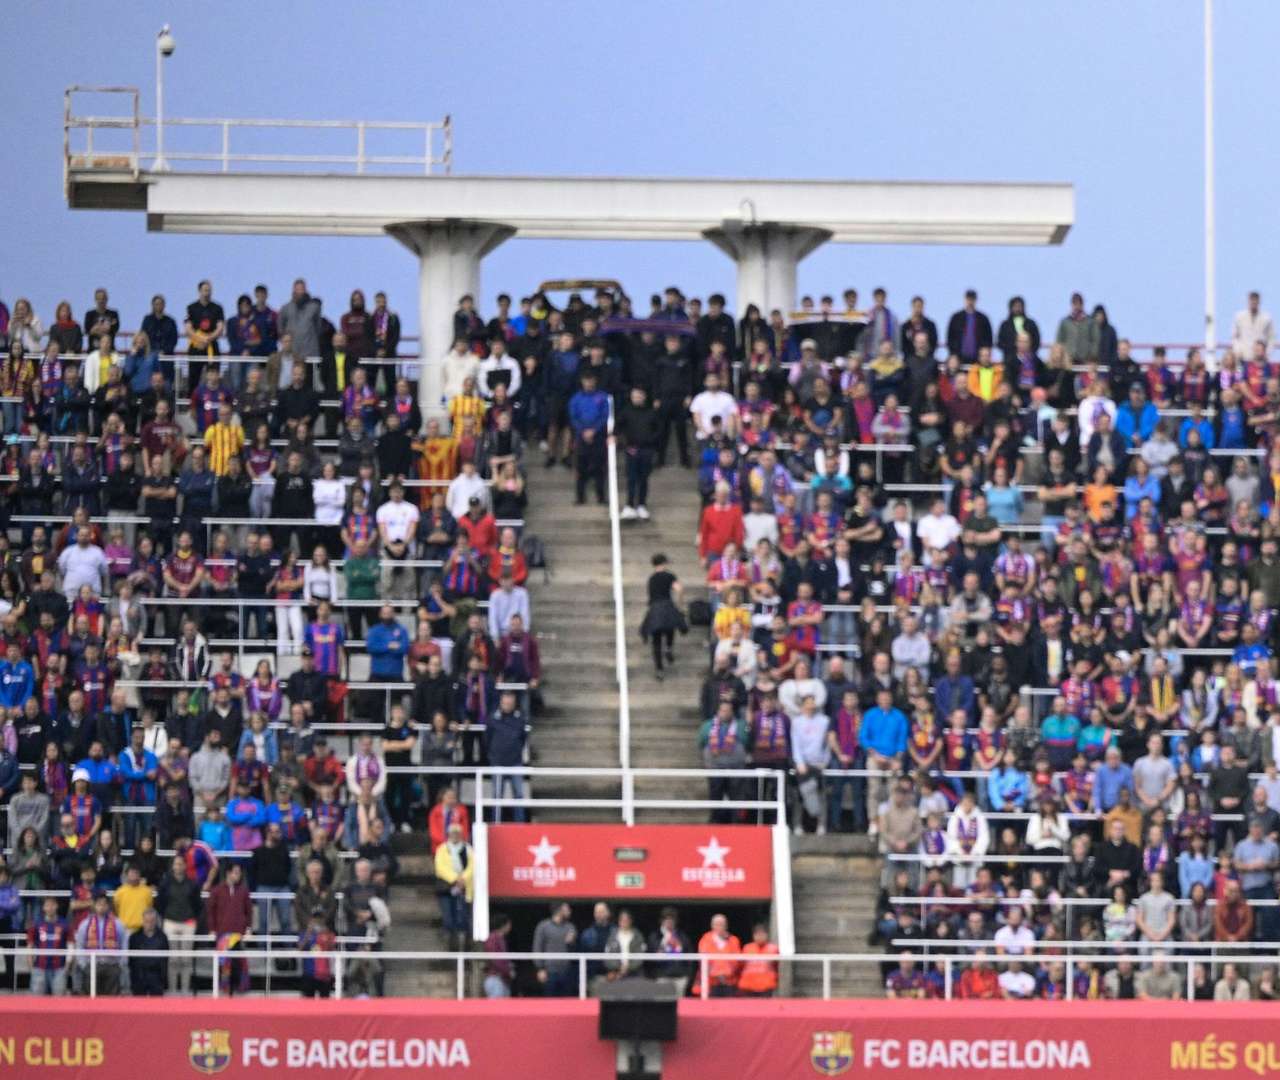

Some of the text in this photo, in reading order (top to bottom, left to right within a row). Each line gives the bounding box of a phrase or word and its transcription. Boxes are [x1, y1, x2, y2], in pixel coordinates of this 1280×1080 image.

[513, 867, 576, 881] ESTRELLA
[682, 868, 745, 882] ESTRELLA
[25, 1039, 105, 1067] CLUB
[242, 1038, 470, 1068] FC BARCELONA
[864, 1040, 1091, 1069] FC BARCELONA
[1170, 1033, 1237, 1070] MÉS
